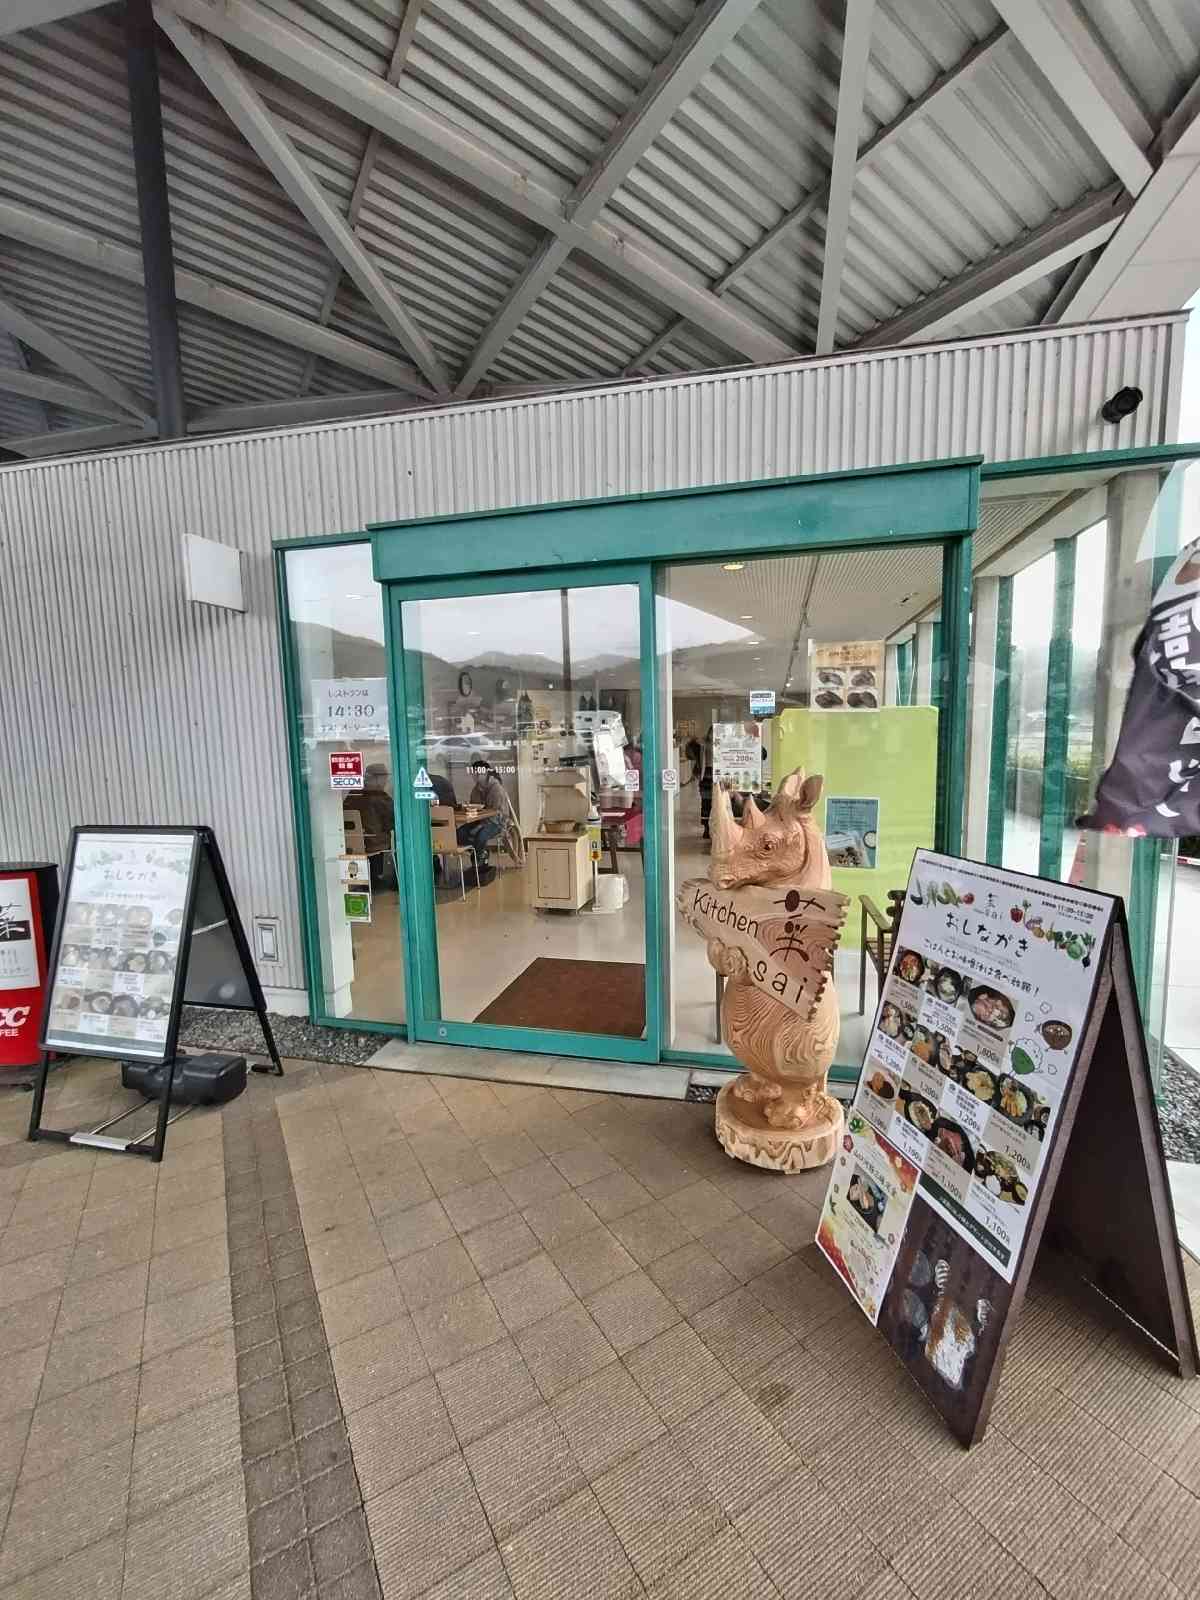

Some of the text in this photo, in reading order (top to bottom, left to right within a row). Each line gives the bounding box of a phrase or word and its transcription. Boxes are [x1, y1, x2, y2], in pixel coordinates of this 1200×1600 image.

[327, 704, 375, 718] 14:30
[332, 776, 362, 786] SECOM
[692, 888, 759, 938] Kitchen
[946, 912, 1029, 958] おしながき
[753, 959, 807, 1004] sai
